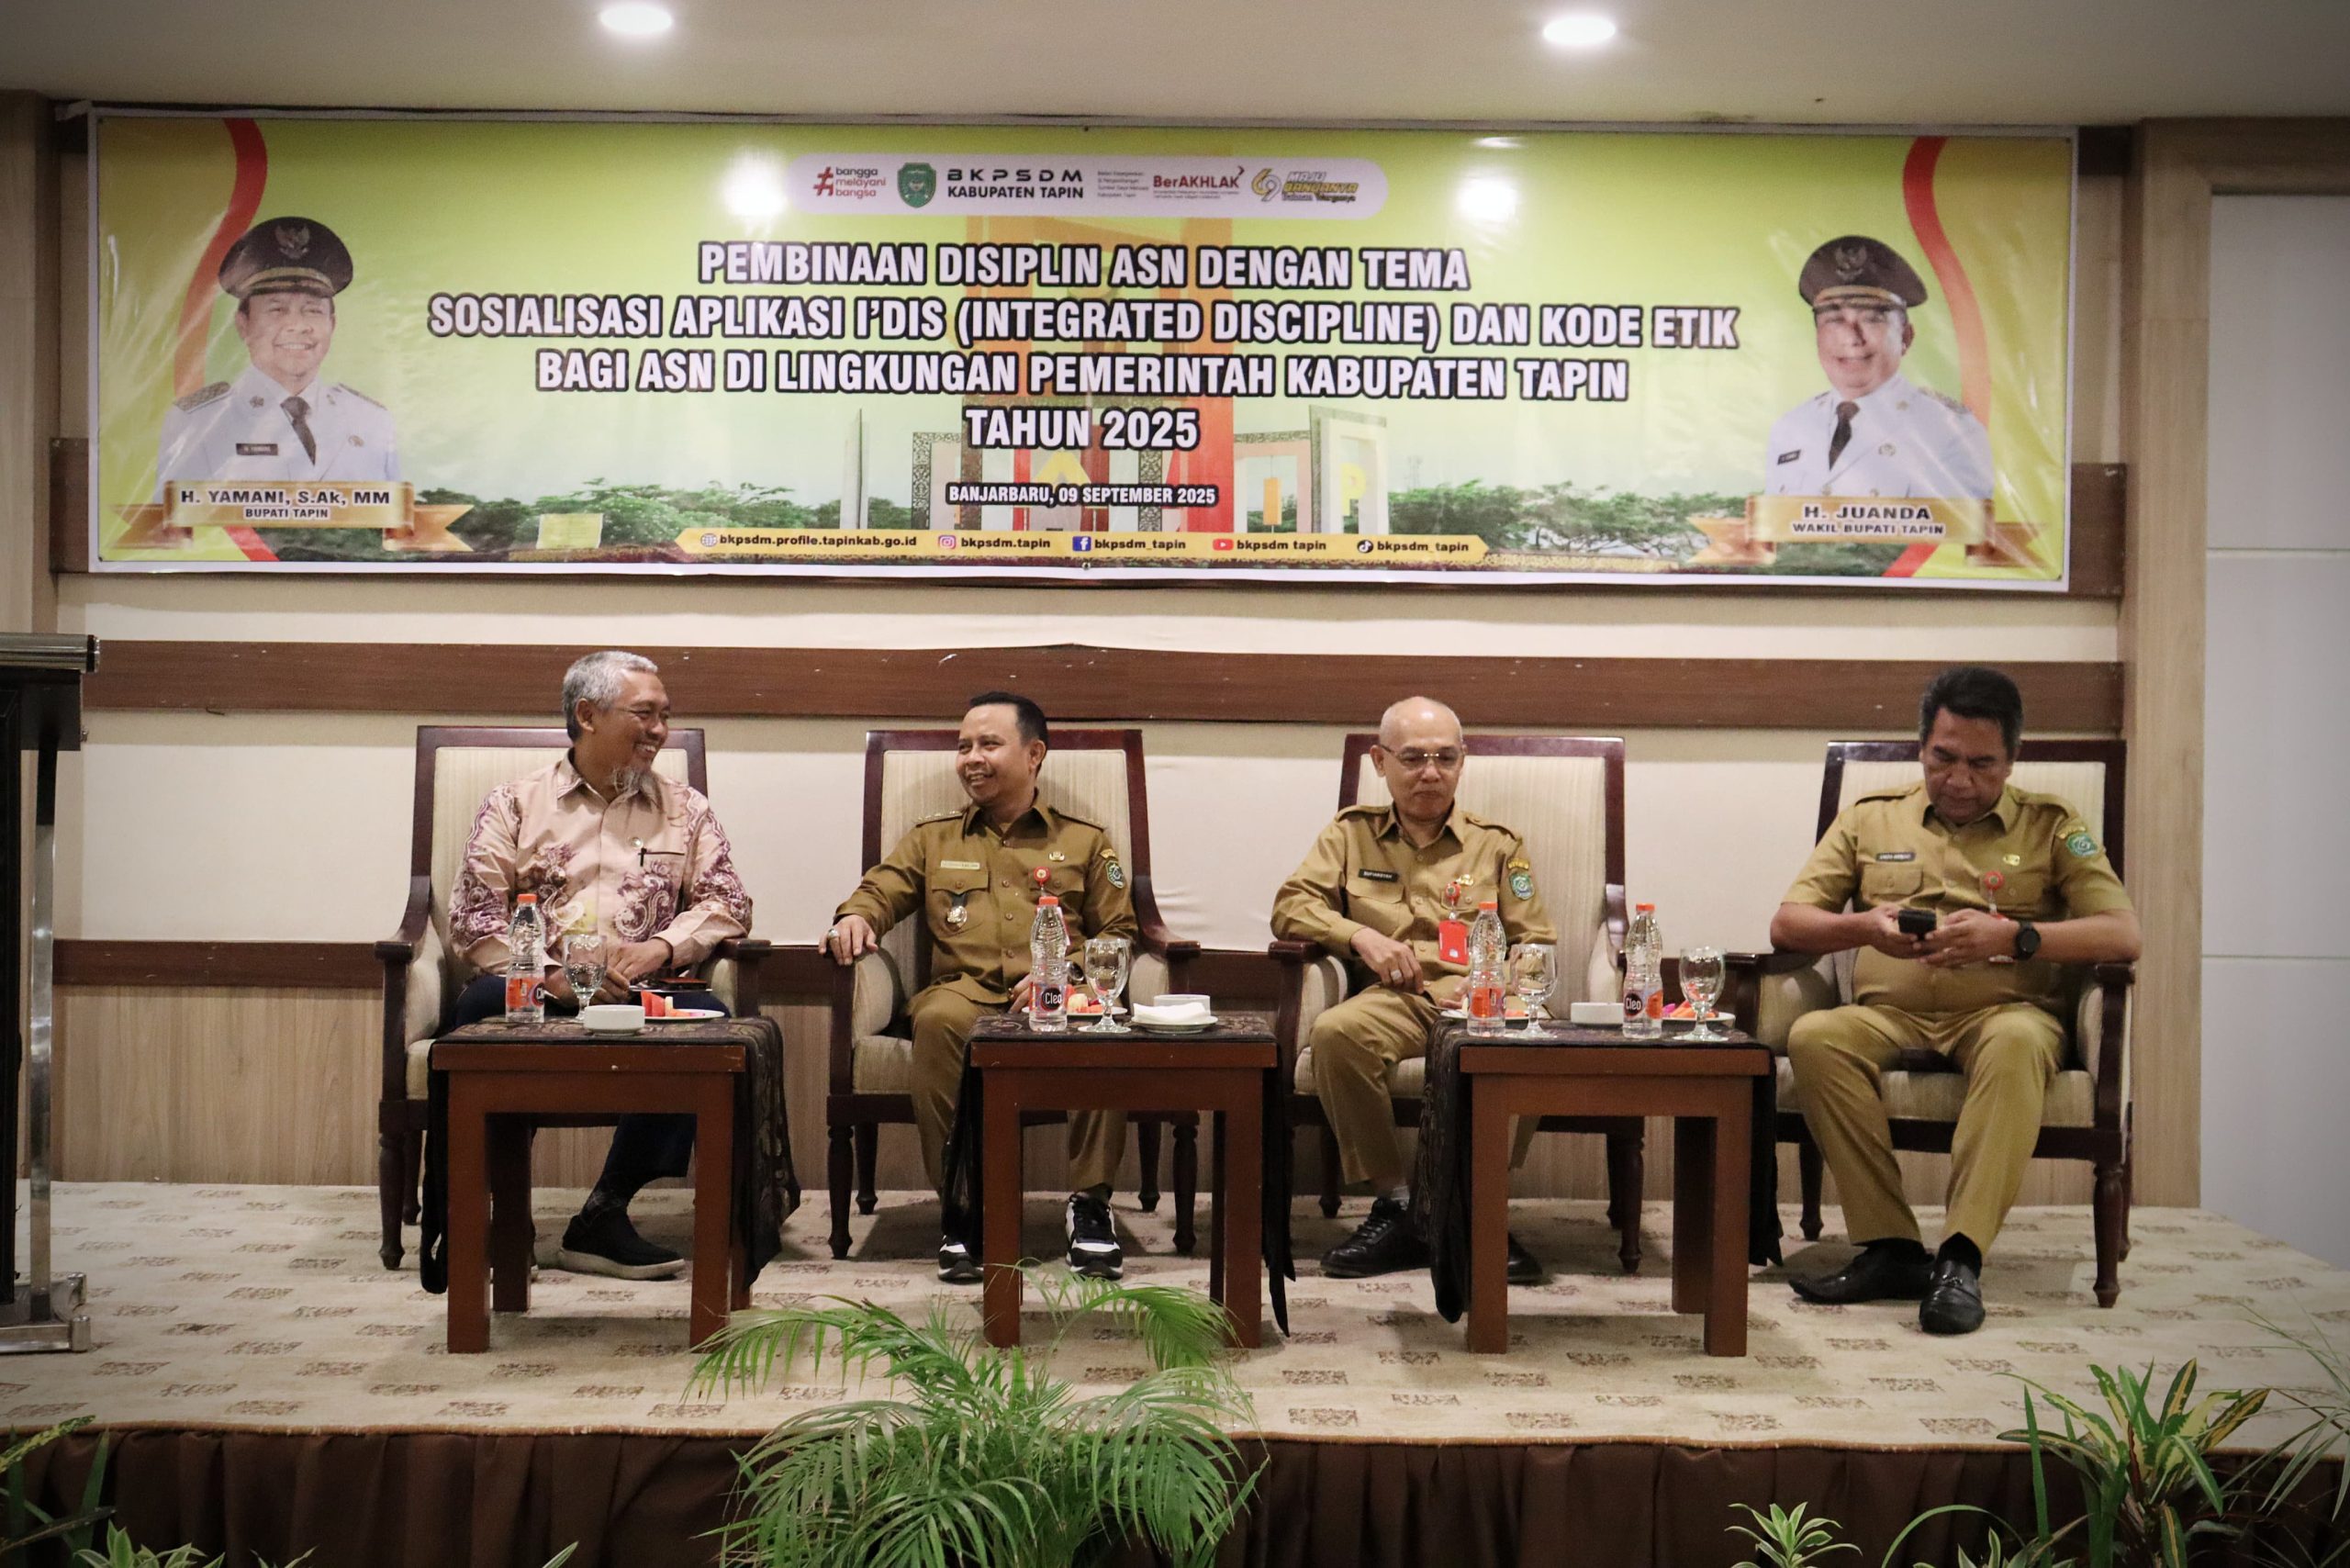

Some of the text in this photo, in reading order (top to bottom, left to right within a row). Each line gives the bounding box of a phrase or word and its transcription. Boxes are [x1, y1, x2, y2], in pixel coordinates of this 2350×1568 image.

[835, 167, 878, 178] bangga
[835, 177, 886, 188] melayani
[1153, 174, 1240, 188] BerAKHLAK
[835, 187, 877, 199] bangsa
[947, 186, 1083, 199] KABUPATEN TAPIN
[699, 242, 1471, 291] PEMBINAAN DISIPLIN ASN DENGAN TEMA
[428, 294, 662, 337] SOSIALISASI
[670, 296, 845, 338] APLIKASI
[957, 297, 1202, 347] (INTEGRATED
[1212, 300, 1440, 352] DISCIPLINE)
[1450, 303, 1529, 345] DAN
[1539, 304, 1642, 347] KODE
[1652, 306, 1740, 349] ETIK
[536, 349, 1628, 401] BAGI ASN DI LINGKUNGAN PEMERINTAH KABUPATEN TAPIN
[962, 406, 1201, 451] TAHUN 2025
[181, 490, 200, 504] H.
[208, 490, 290, 506] YAMANI,
[353, 491, 390, 504] MM
[947, 485, 1216, 506] BANJARBARU, 09 SEPTEMBER 2025
[245, 508, 329, 518] BUPATI TAPIN
[1804, 506, 1930, 520] H. JUANDA
[1793, 523, 1944, 534] WAKIL BUPATI TAPIN
[719, 534, 917, 548] bkpsdm.profile.tapinkab.go.id
[961, 537, 1051, 549] bkpsdm.tapin
[1094, 539, 1186, 551] bkpsdm_tapin
[1045, 991, 1062, 1004] Cleo
[1626, 997, 1641, 1011] Cleo
